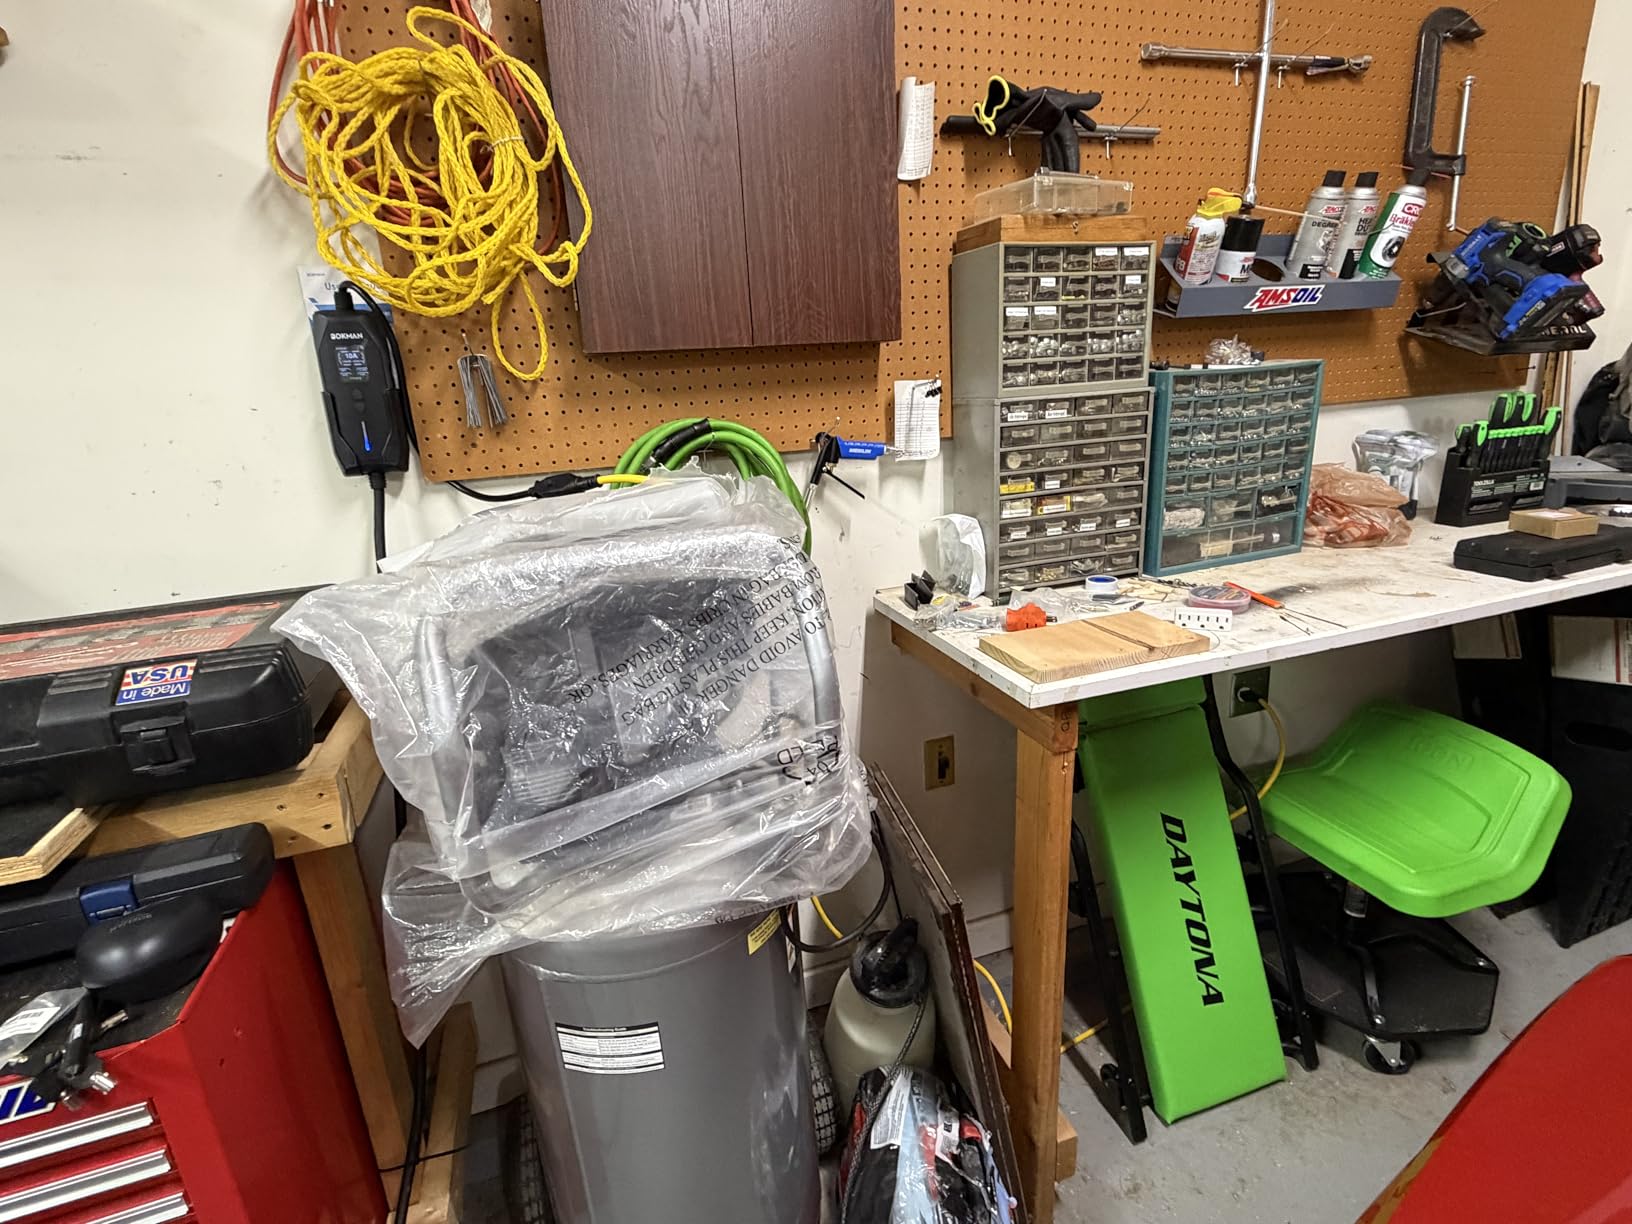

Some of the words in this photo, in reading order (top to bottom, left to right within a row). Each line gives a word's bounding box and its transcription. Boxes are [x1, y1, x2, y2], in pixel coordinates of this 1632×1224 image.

[1248, 286, 1322, 309] AMSOIL
[329, 332, 364, 341] BOKMAN
[748, 567, 781, 593] BAG
[740, 584, 793, 623] BABIES
[707, 617, 738, 645] AND
[753, 612, 788, 644] KEEP
[803, 616, 824, 636] TO
[716, 637, 752, 666] THIS
[758, 630, 802, 660] AVOID
[131, 664, 189, 685] USA
[655, 658, 717, 704] PLASTIC
[696, 657, 759, 703] DANGER
[122, 690, 138, 701] in
[141, 683, 186, 697] Made
[568, 682, 594, 704] OR
[620, 697, 656, 725] BAG
[1160, 812, 1225, 1006] DAYTONA
